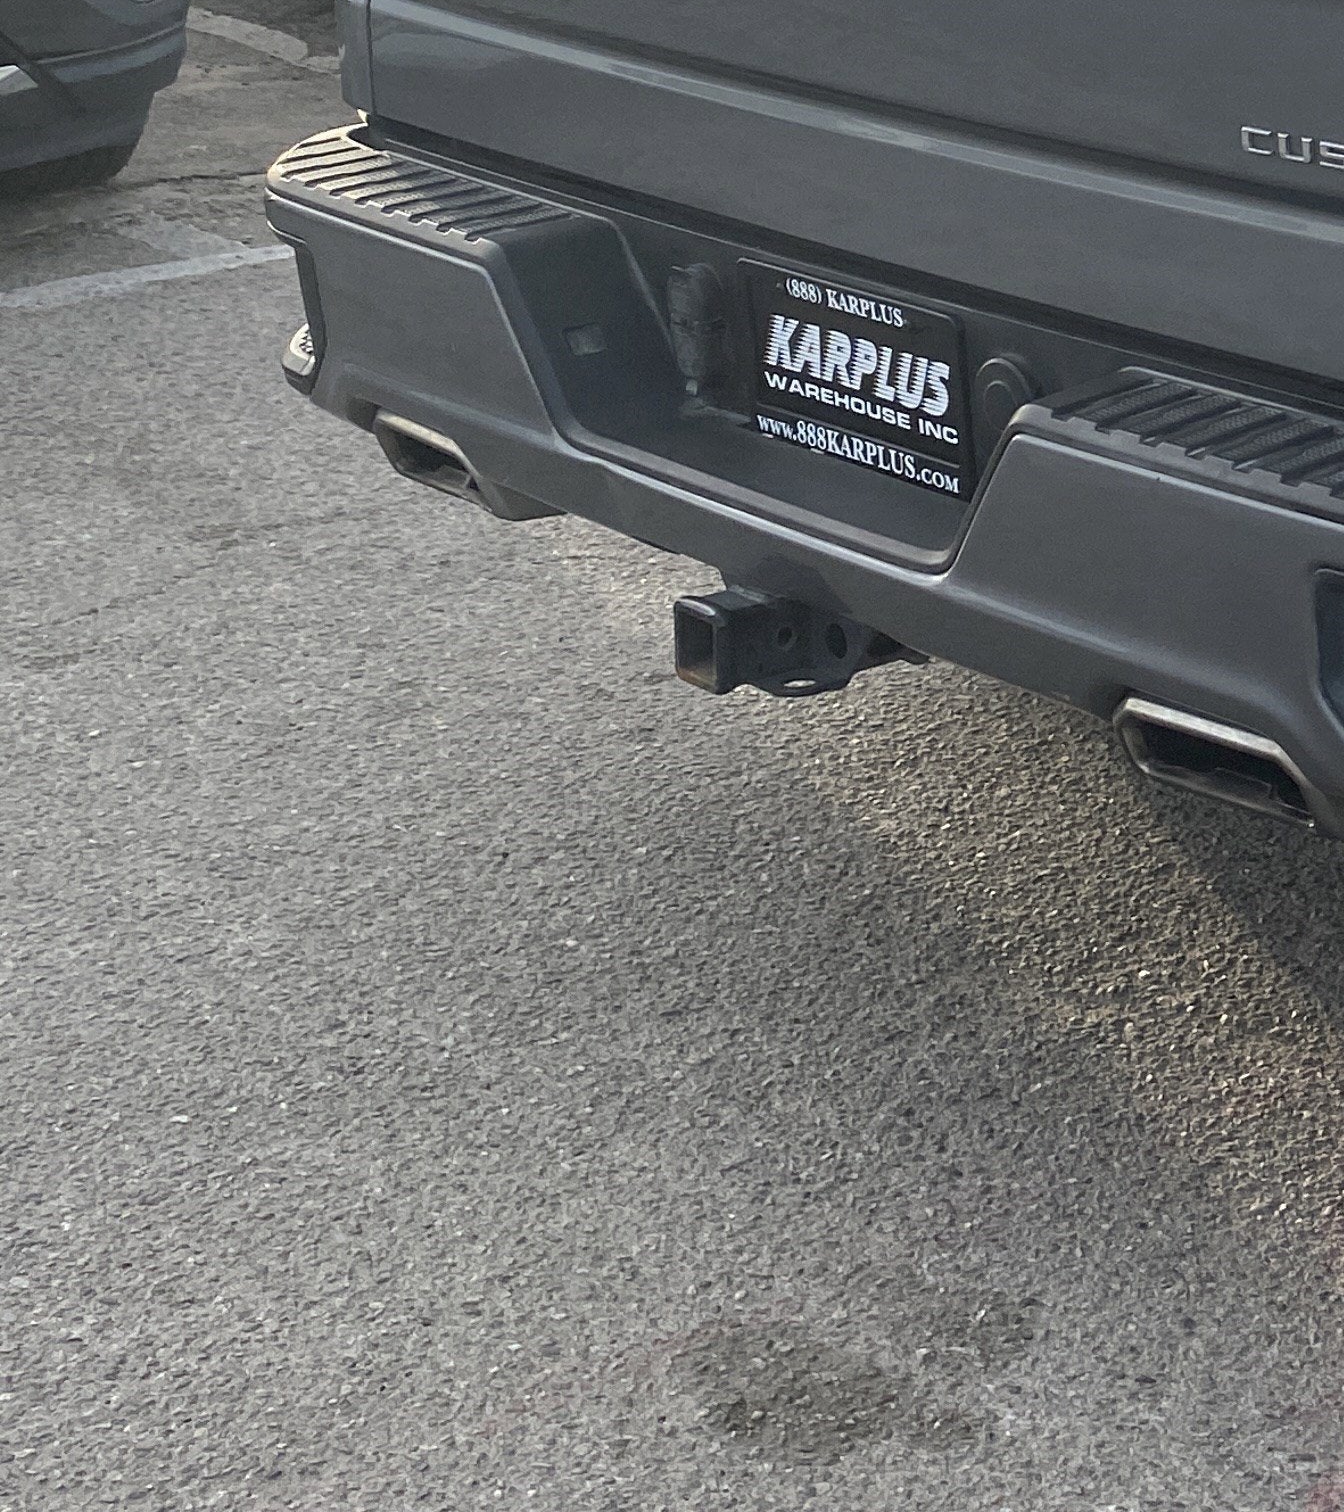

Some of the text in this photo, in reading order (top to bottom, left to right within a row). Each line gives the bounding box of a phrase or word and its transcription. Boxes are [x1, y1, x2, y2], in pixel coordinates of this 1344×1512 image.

[785, 277, 904, 328] (888) KARPLUS
[763, 314, 951, 417] KARPLUS
[764, 371, 960, 445] WAREHOUSE INC
